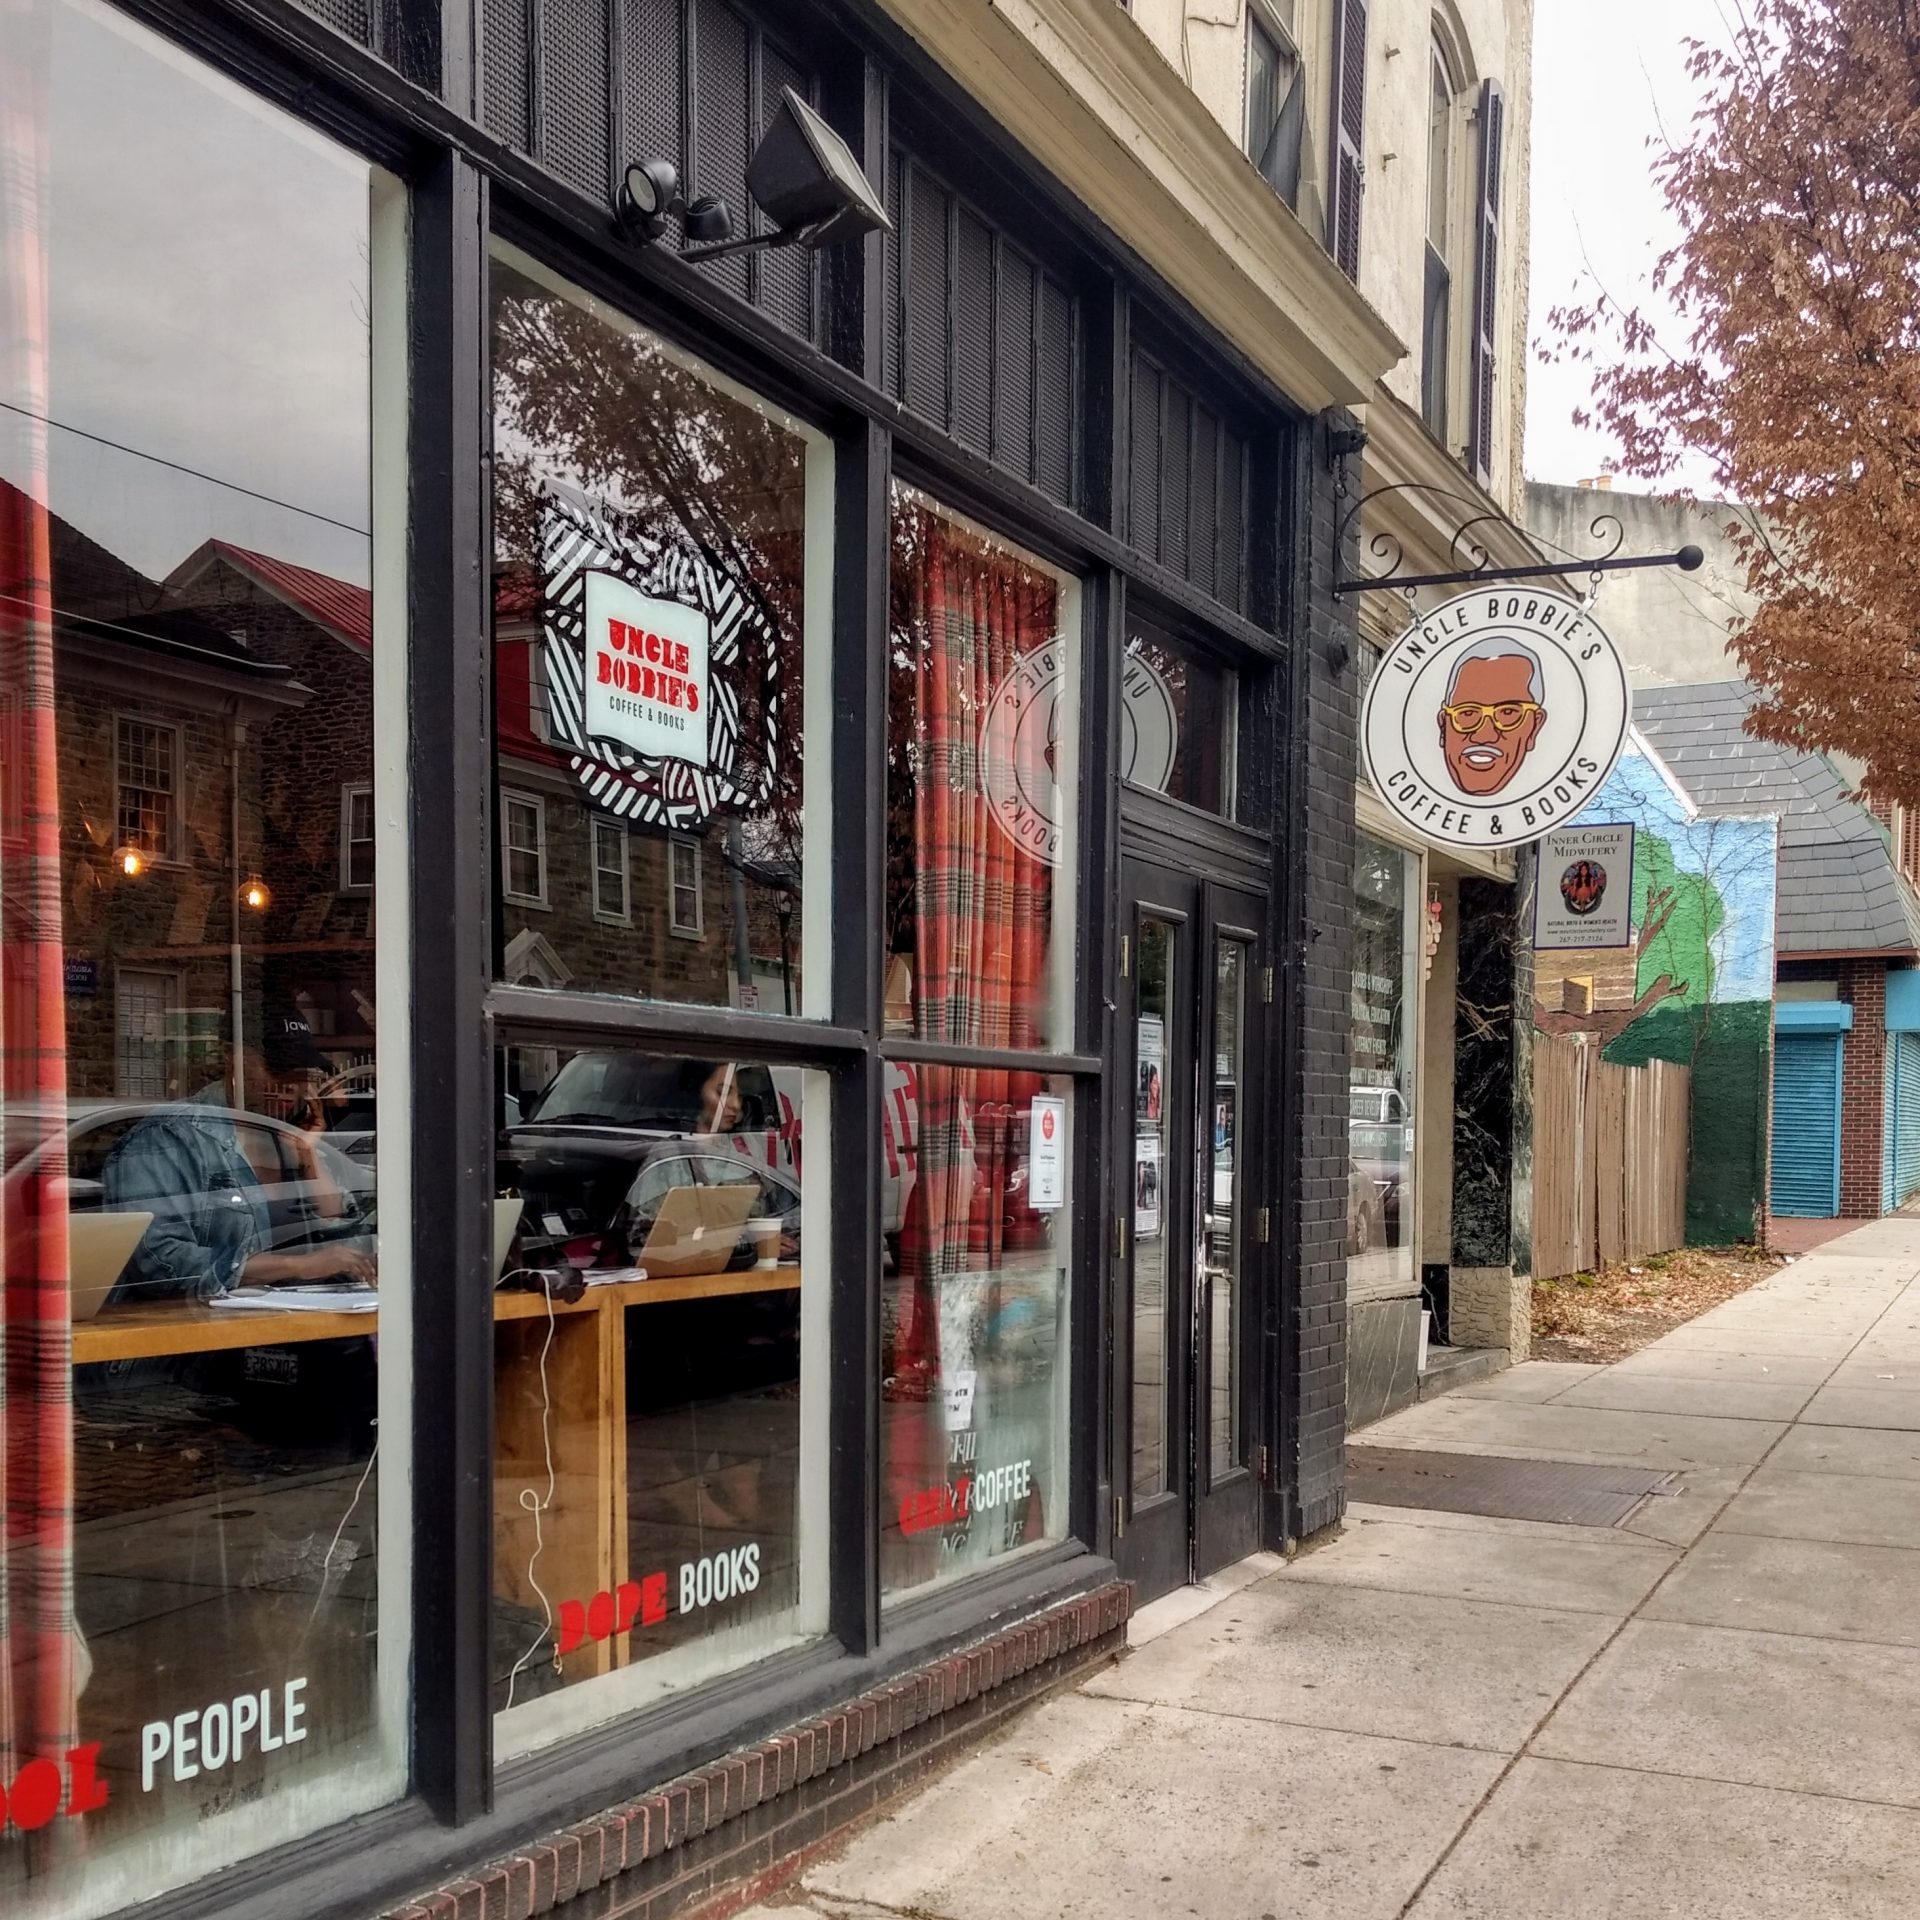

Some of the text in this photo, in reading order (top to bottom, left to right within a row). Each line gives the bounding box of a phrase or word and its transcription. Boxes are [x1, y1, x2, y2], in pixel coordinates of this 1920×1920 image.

[607, 617, 690, 675] UNCLE
[1393, 597, 1602, 674] UNCLE BOBBIE'S
[596, 650, 700, 713] BOBBIE'S
[609, 695, 685, 731] COFFEE & BOOKS
[1387, 756, 1598, 835] COFFEE & BOOKS
[1547, 832, 1624, 846] INNER CIRCLE
[1554, 846, 1618, 857] MIDWIFERY
[975, 1459, 1032, 1512] COFFEE
[557, 1542, 761, 1656] DOPE BOOKS
[141, 1676, 308, 1792] PEOPLE
